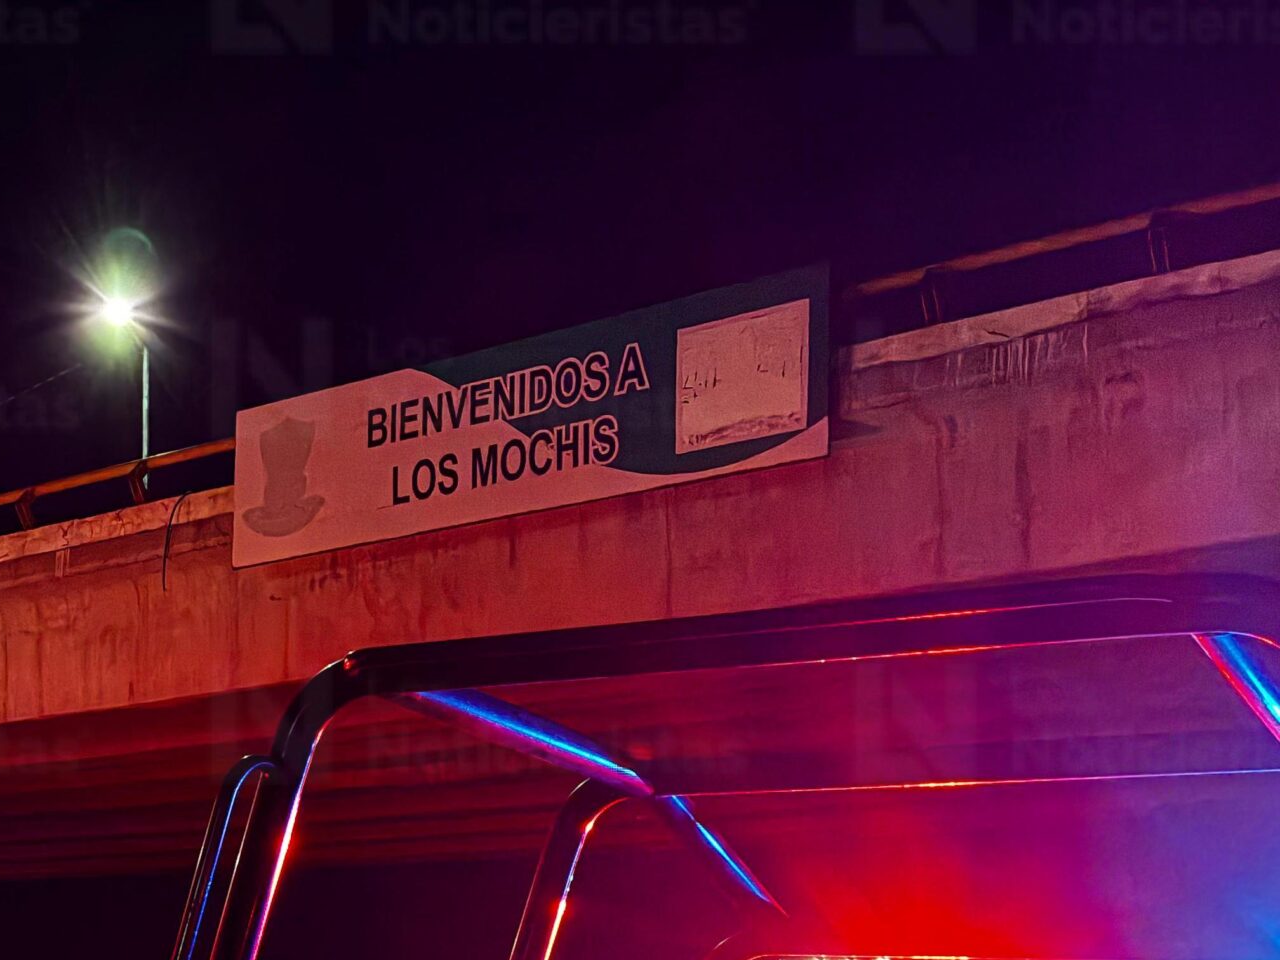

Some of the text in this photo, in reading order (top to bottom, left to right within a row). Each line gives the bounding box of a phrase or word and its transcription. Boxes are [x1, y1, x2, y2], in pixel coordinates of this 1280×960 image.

[367, 352, 610, 448] BIENVENIDOS
[614, 343, 650, 396] A
[392, 415, 618, 505] LOS MOCHIS
